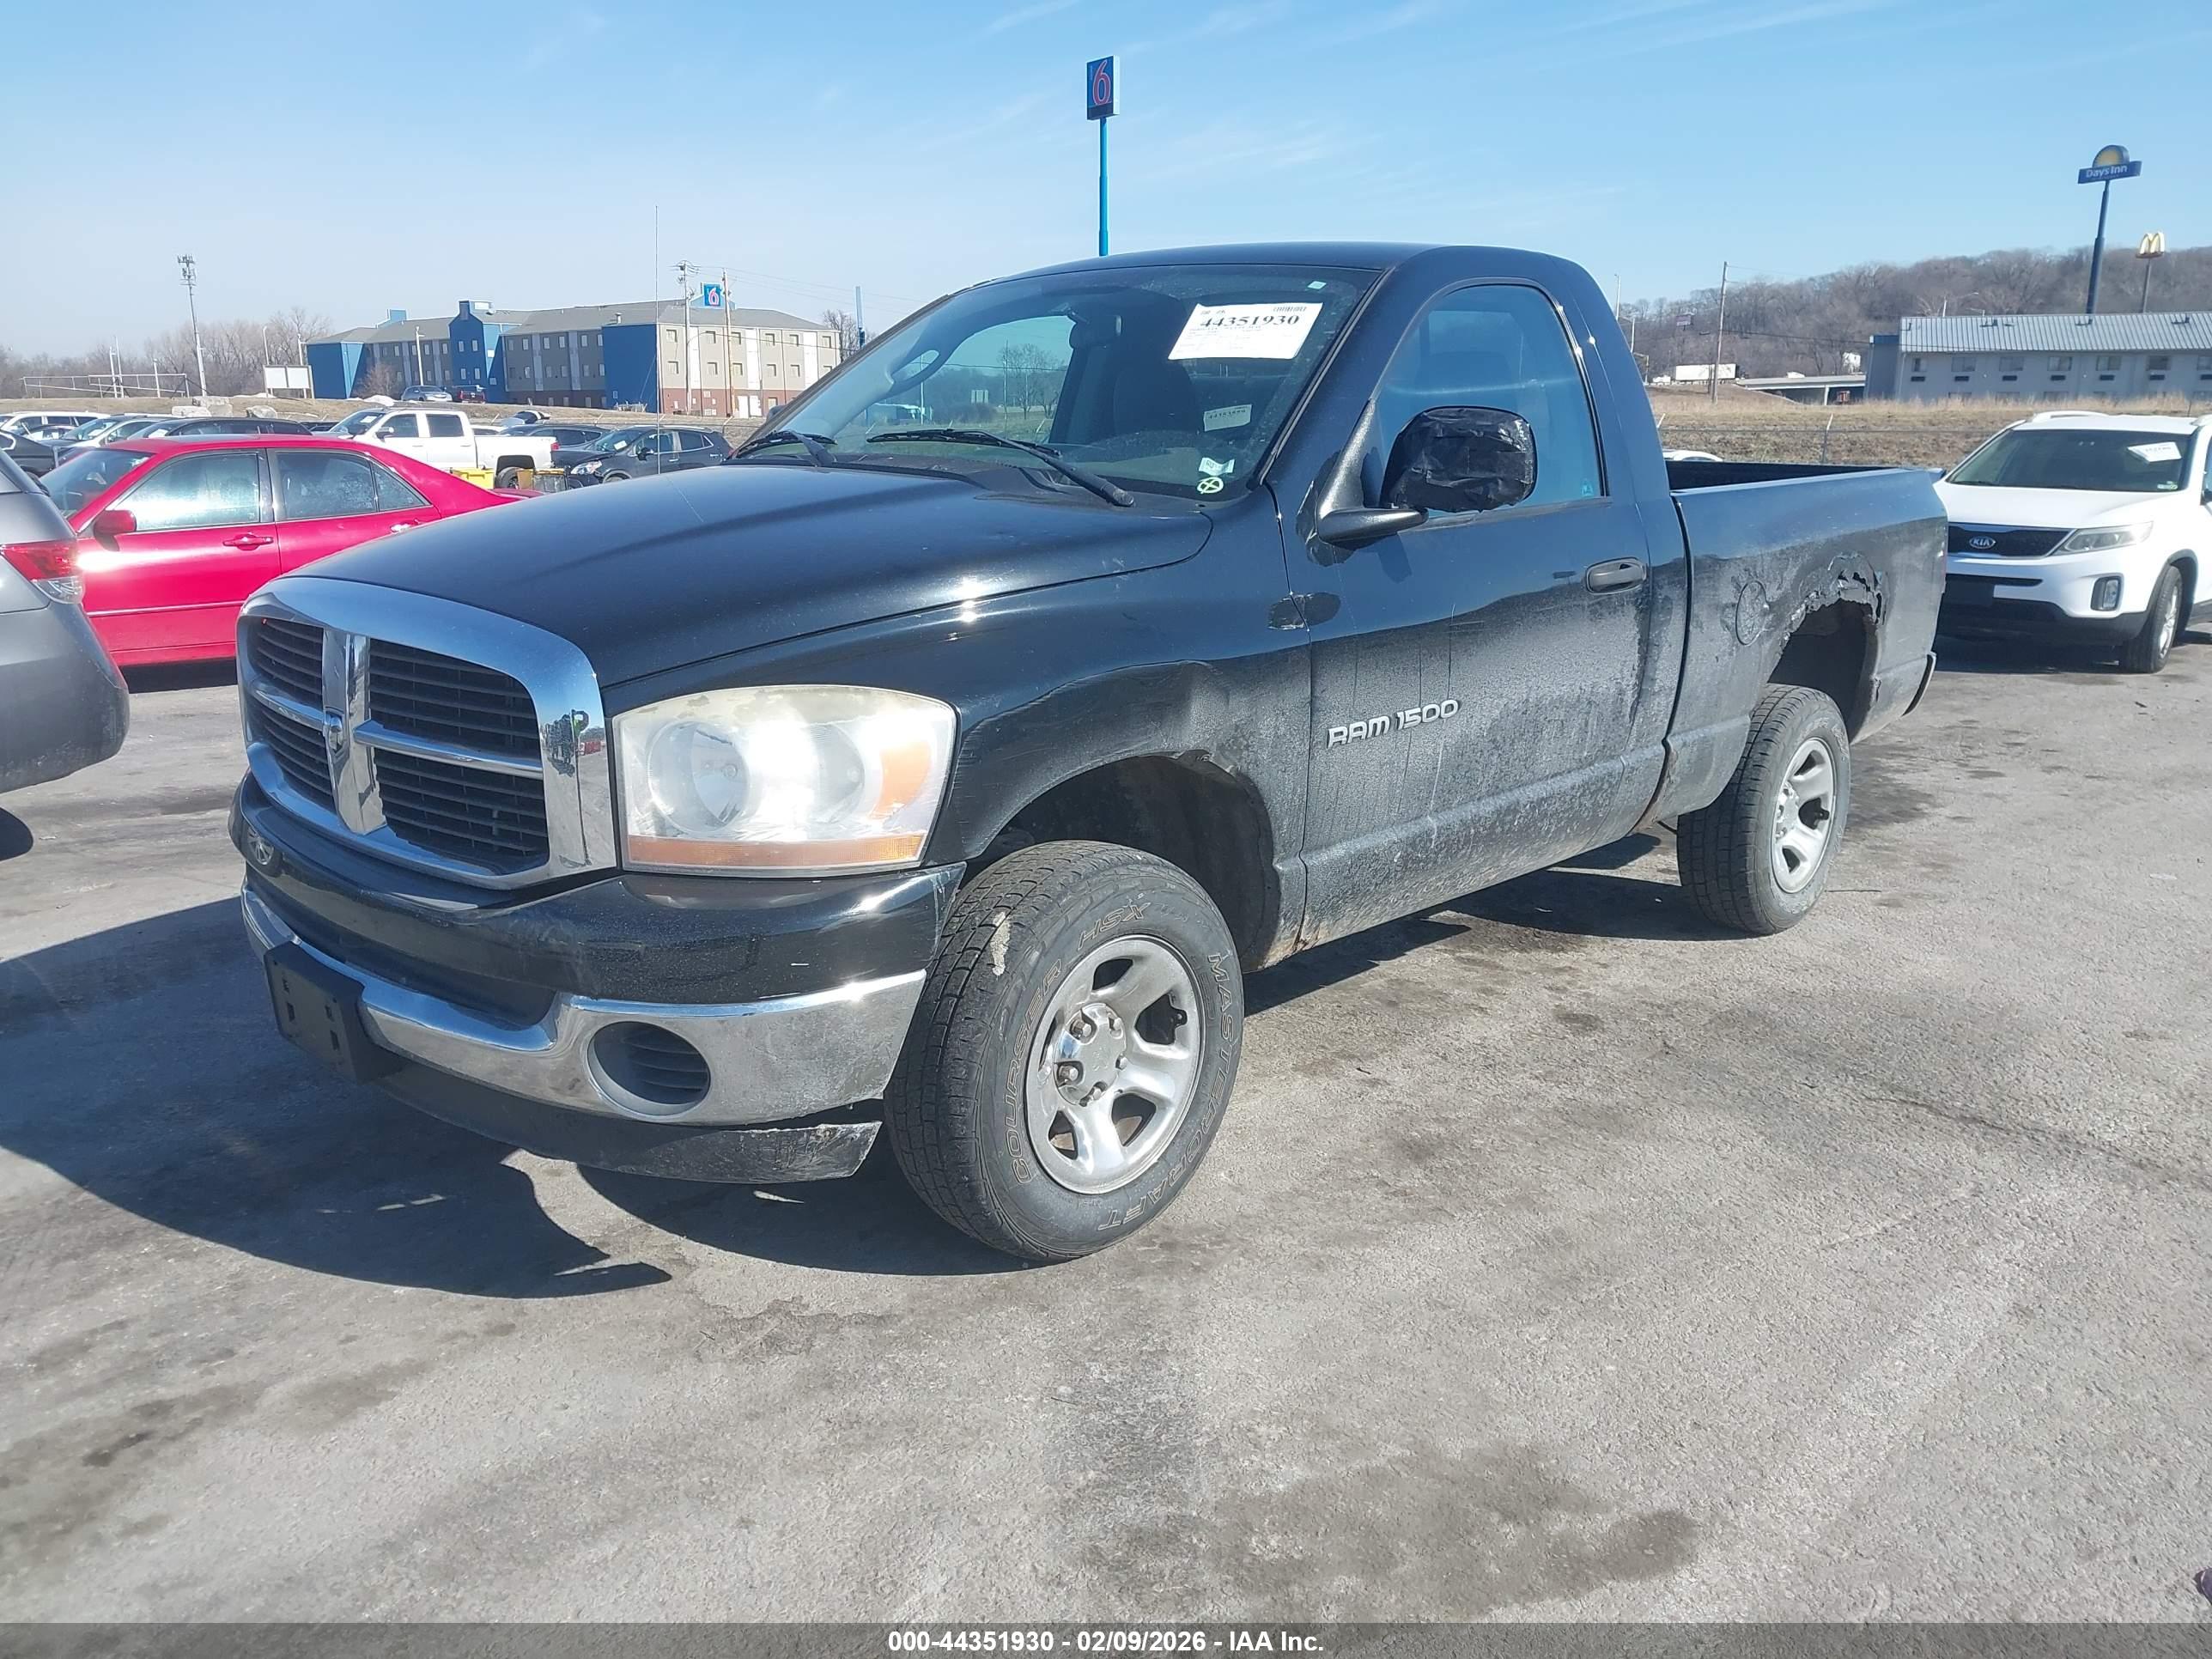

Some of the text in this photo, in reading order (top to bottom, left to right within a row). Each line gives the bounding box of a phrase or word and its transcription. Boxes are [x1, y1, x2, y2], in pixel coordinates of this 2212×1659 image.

[1093, 59, 1110, 105] 6
[2086, 167, 2110, 179] Days
[2111, 164, 2128, 174] Inn
[708, 287, 720, 306] 6
[1200, 315, 1300, 327] 44351930
[1972, 537, 1990, 546] KIA
[1327, 699, 1460, 750] RAM 1500
[1003, 902, 1152, 1185] COURSER HSX
[1097, 953, 1233, 1231] MASTERCRAFT
